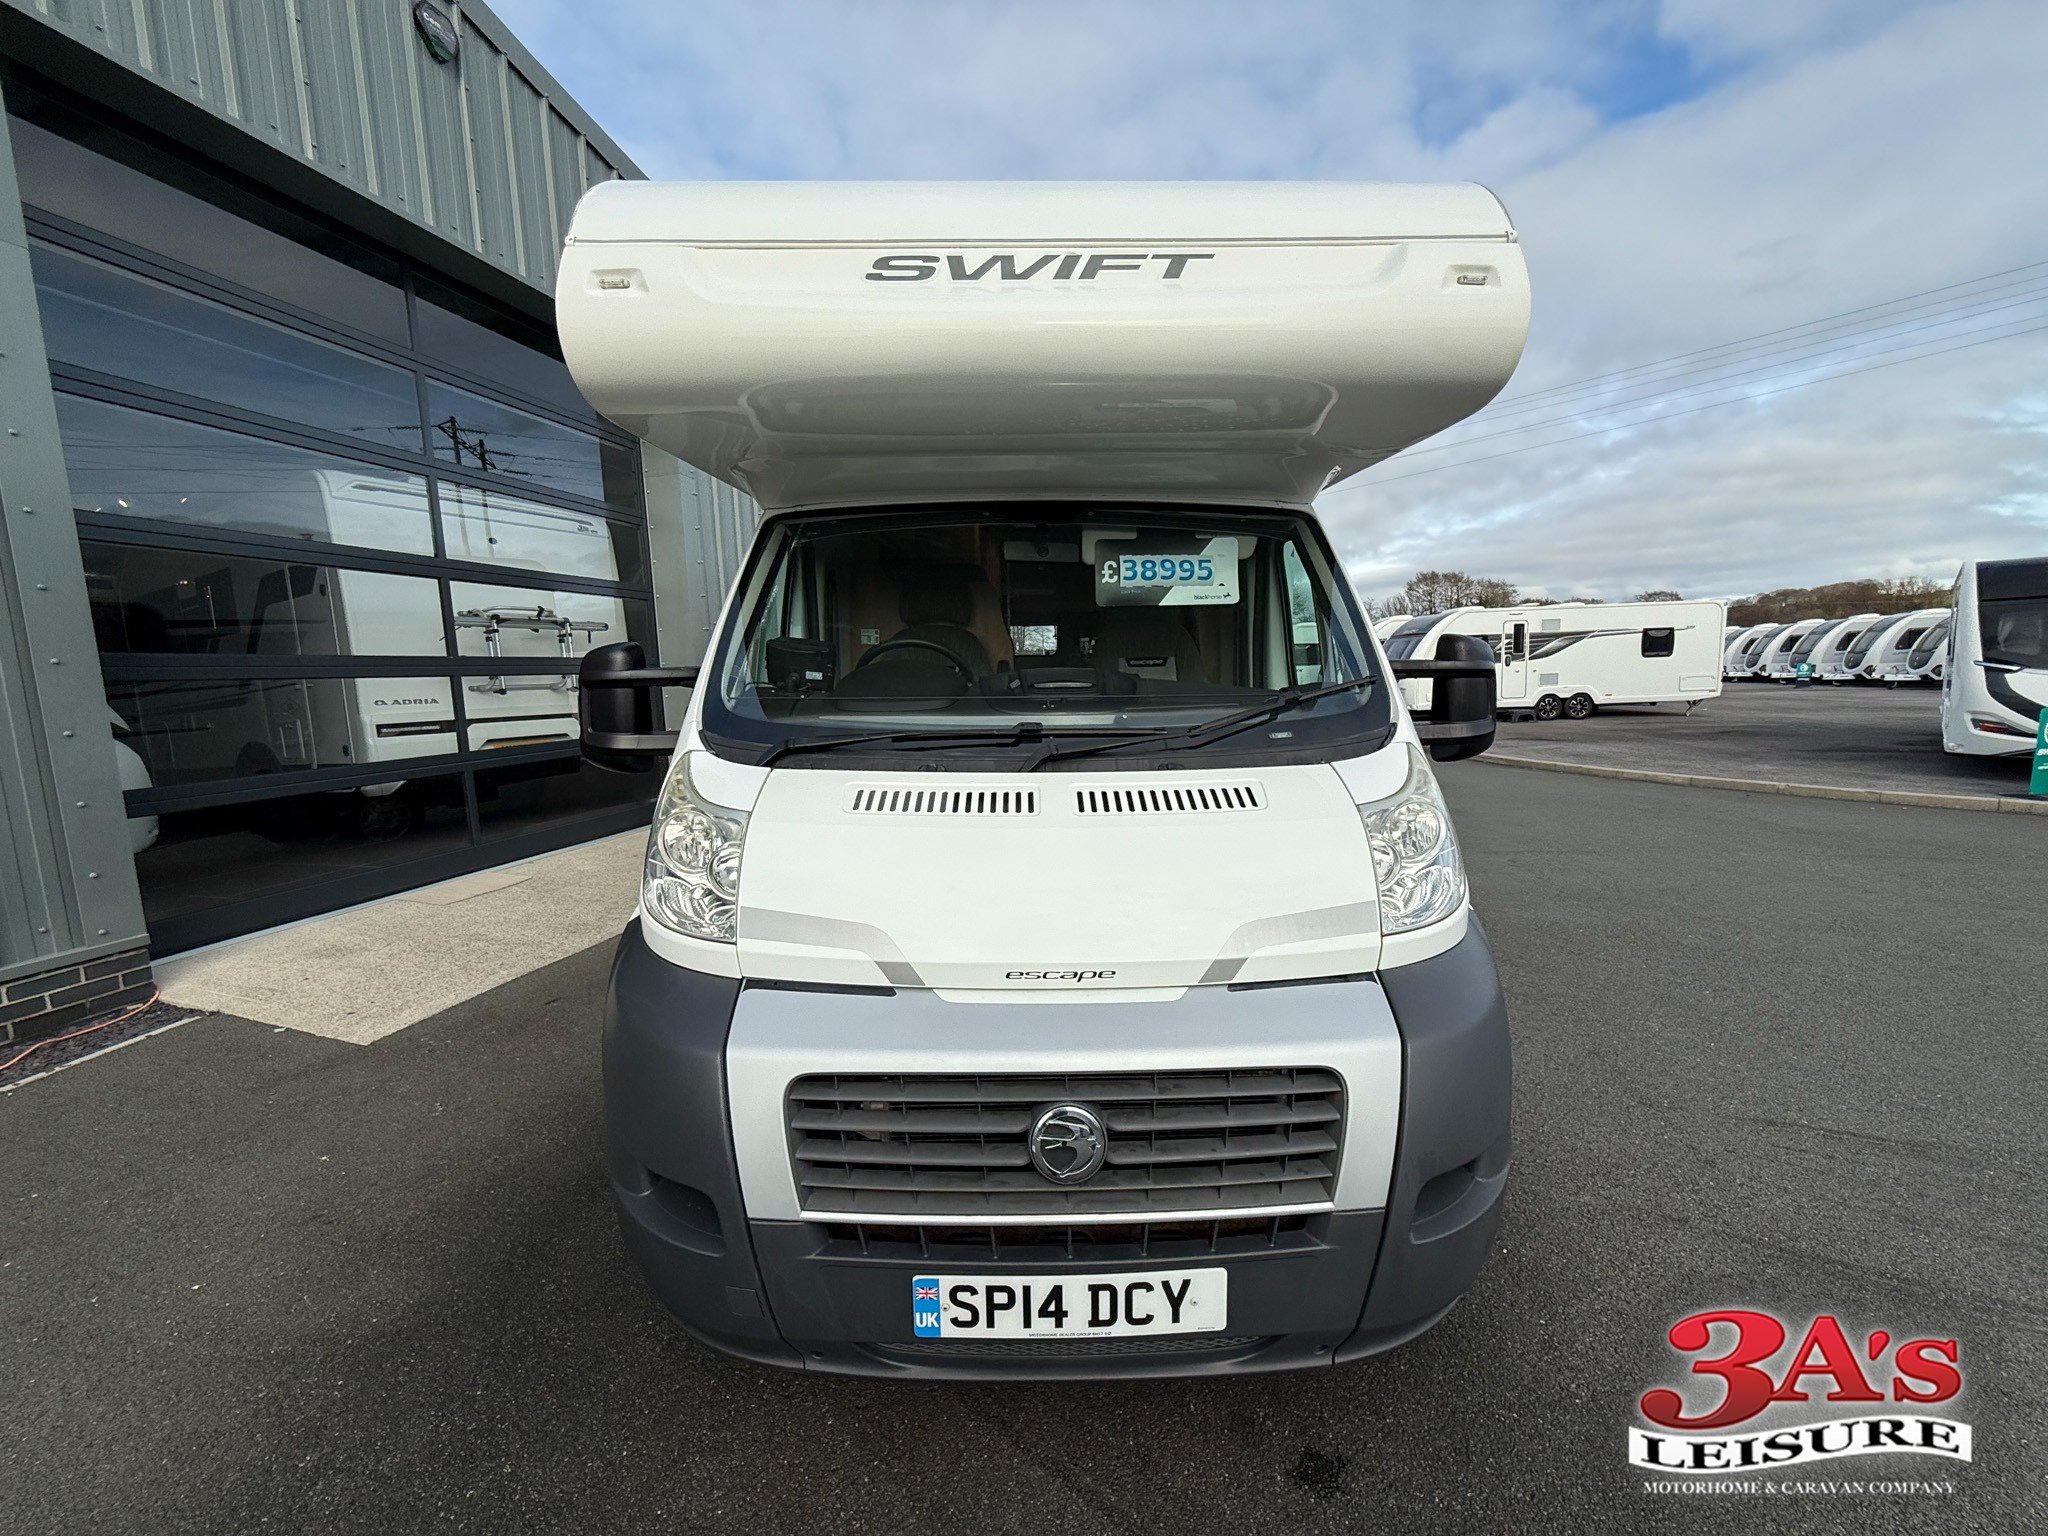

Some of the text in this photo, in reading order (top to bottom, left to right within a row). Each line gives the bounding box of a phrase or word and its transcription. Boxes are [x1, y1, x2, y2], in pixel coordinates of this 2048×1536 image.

[865, 253, 1216, 282] SWIFT
[1005, 970, 1117, 983] escape
[949, 1278, 1192, 1329] SP14 DCY
[915, 1312, 939, 1328] UK
